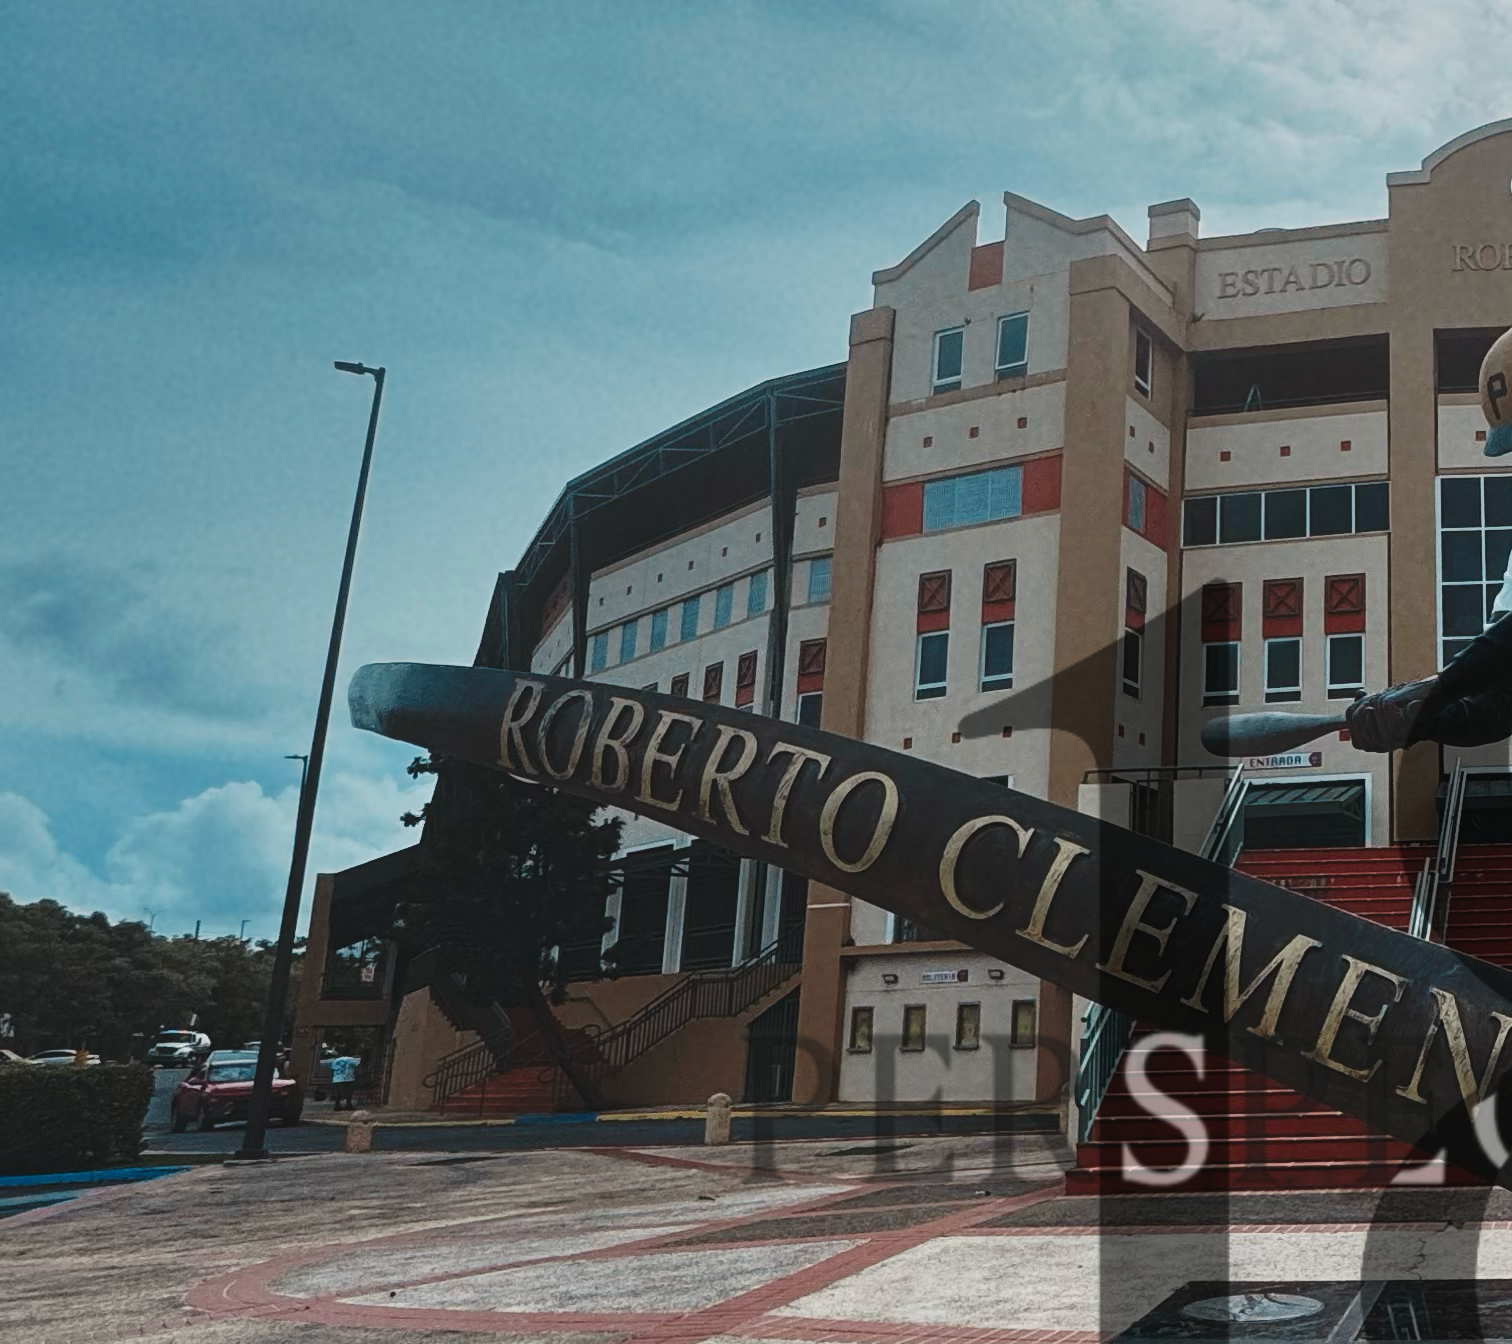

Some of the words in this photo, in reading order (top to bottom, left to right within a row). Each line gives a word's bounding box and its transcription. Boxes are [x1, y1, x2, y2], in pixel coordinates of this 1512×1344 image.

[1217, 258, 1372, 299] ESTADIO
[1487, 372, 1508, 420] P
[497, 677, 900, 873] ROBERTO
[1249, 755, 1302, 768] ENTRADA
